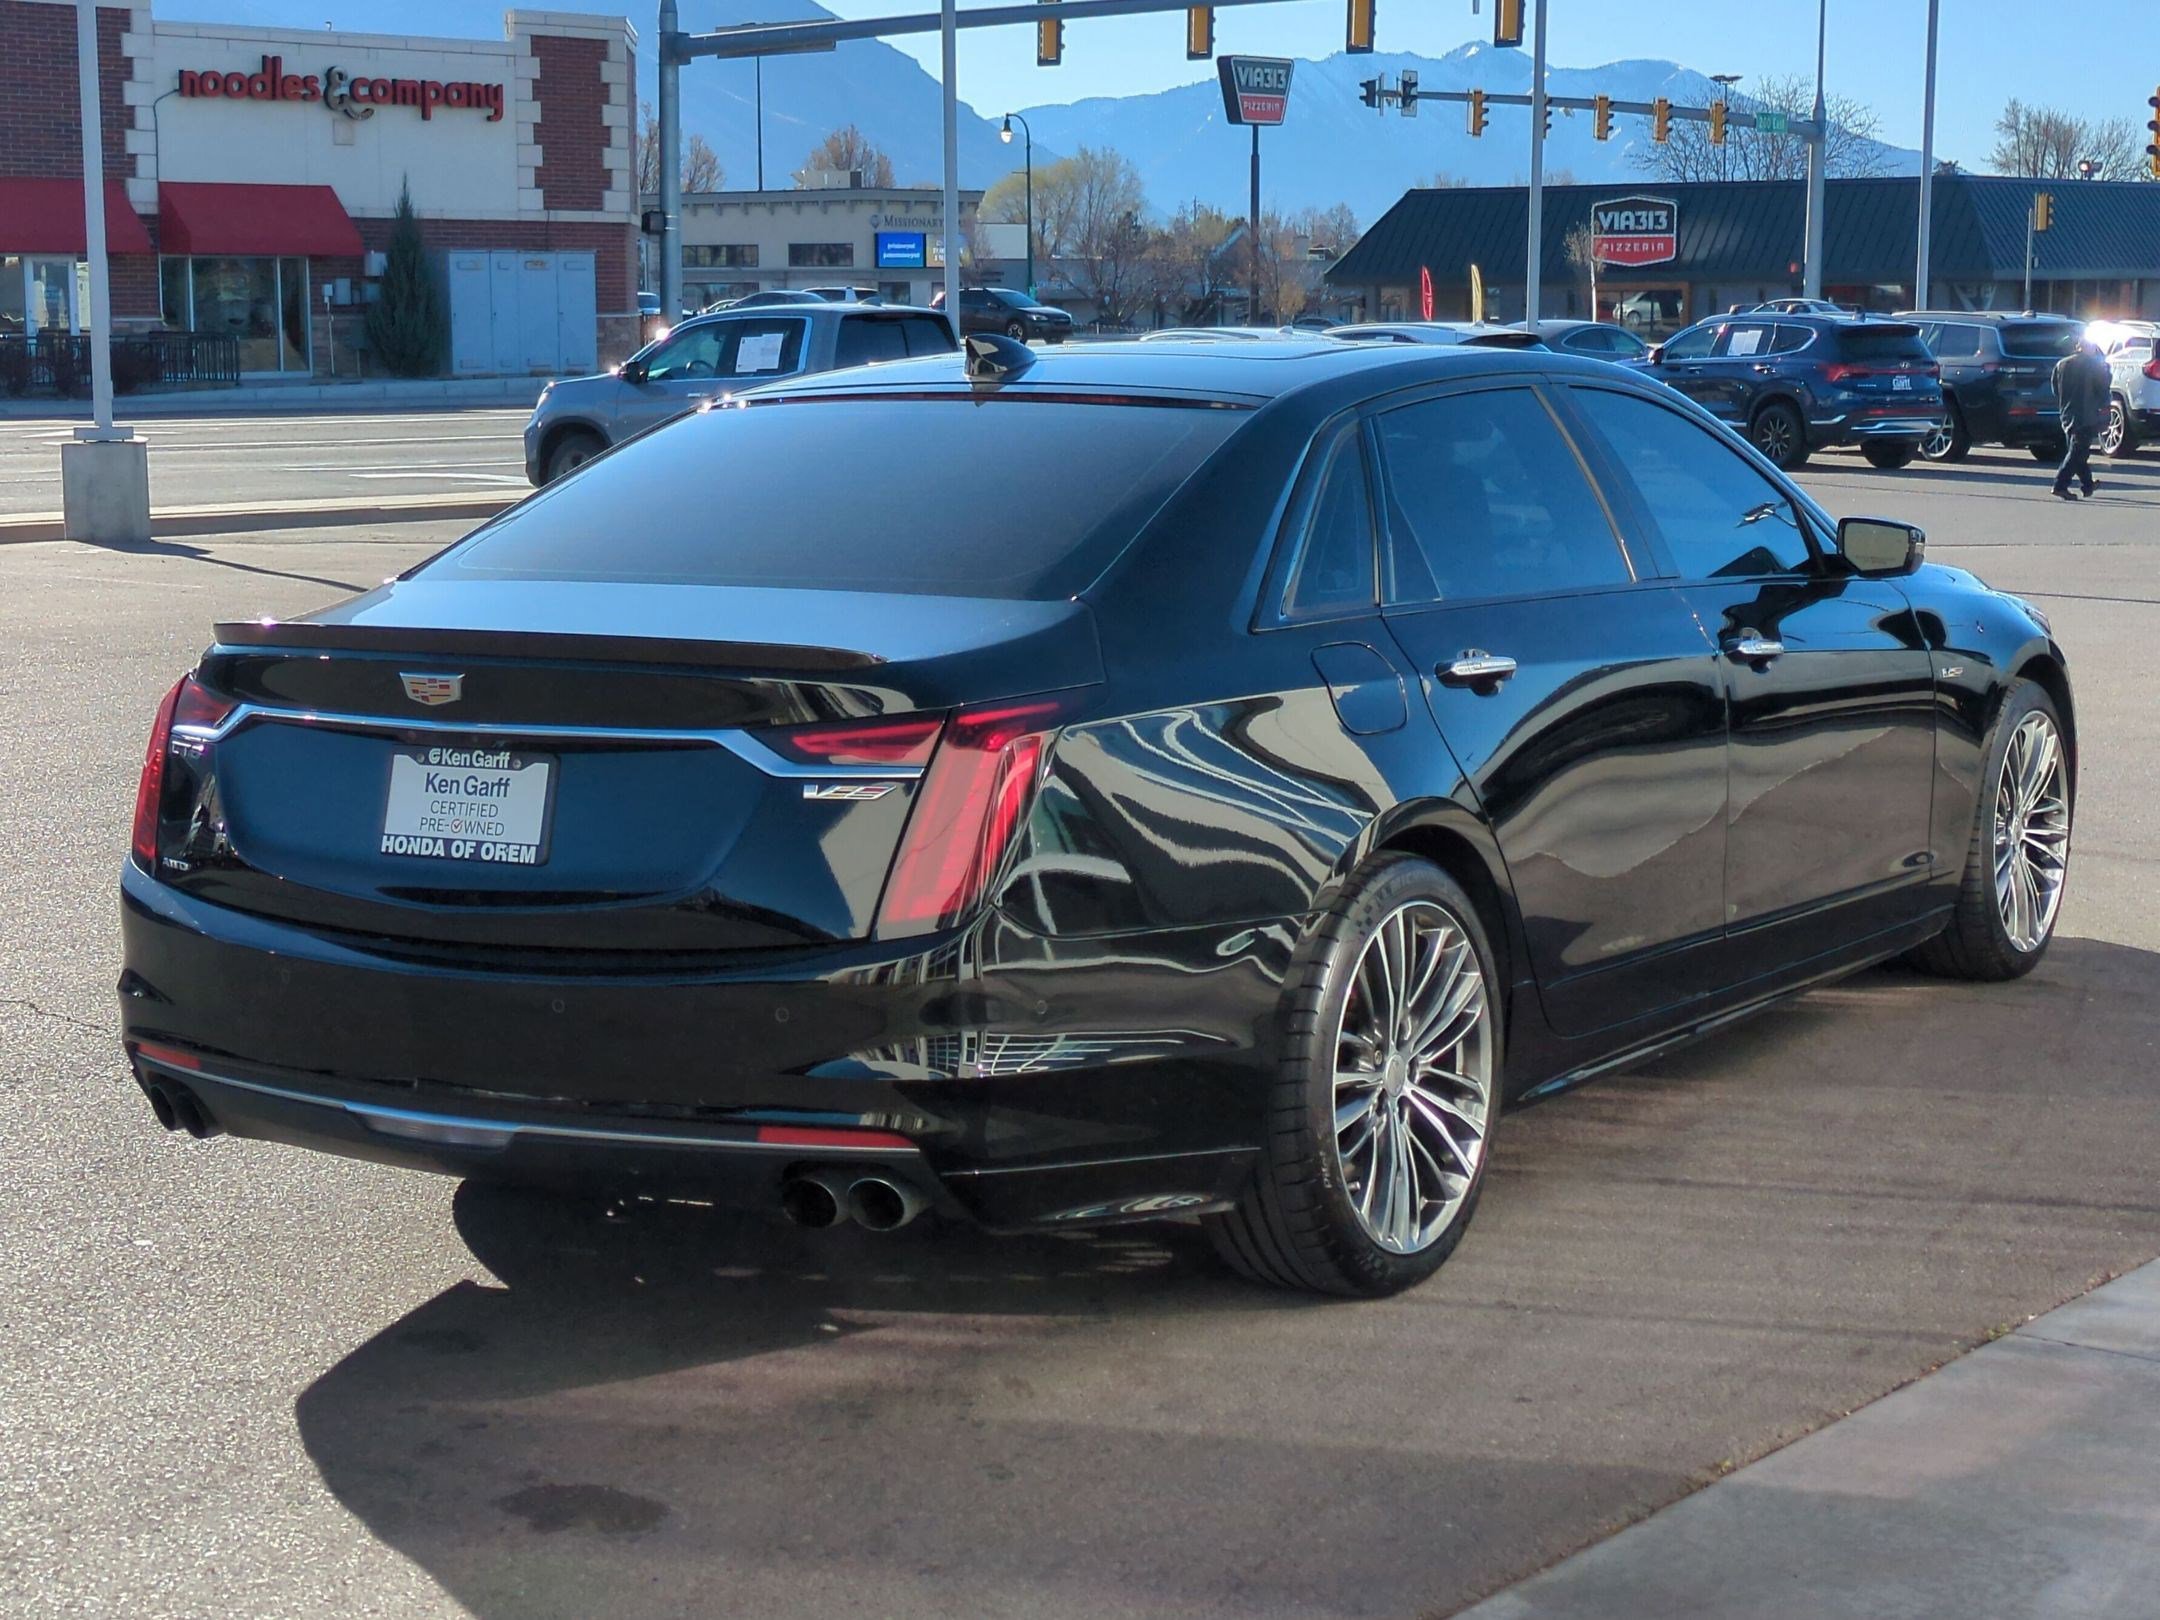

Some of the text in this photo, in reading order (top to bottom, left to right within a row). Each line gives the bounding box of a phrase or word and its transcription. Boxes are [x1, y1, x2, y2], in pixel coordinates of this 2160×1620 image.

[179, 55, 321, 100] noodles
[350, 77, 504, 122] company
[441, 749, 511, 769] Ken Garff
[425, 772, 511, 798] Ken Garff
[430, 800, 499, 818] CERTIFIED
[381, 835, 537, 864] HONDA OF OREM
